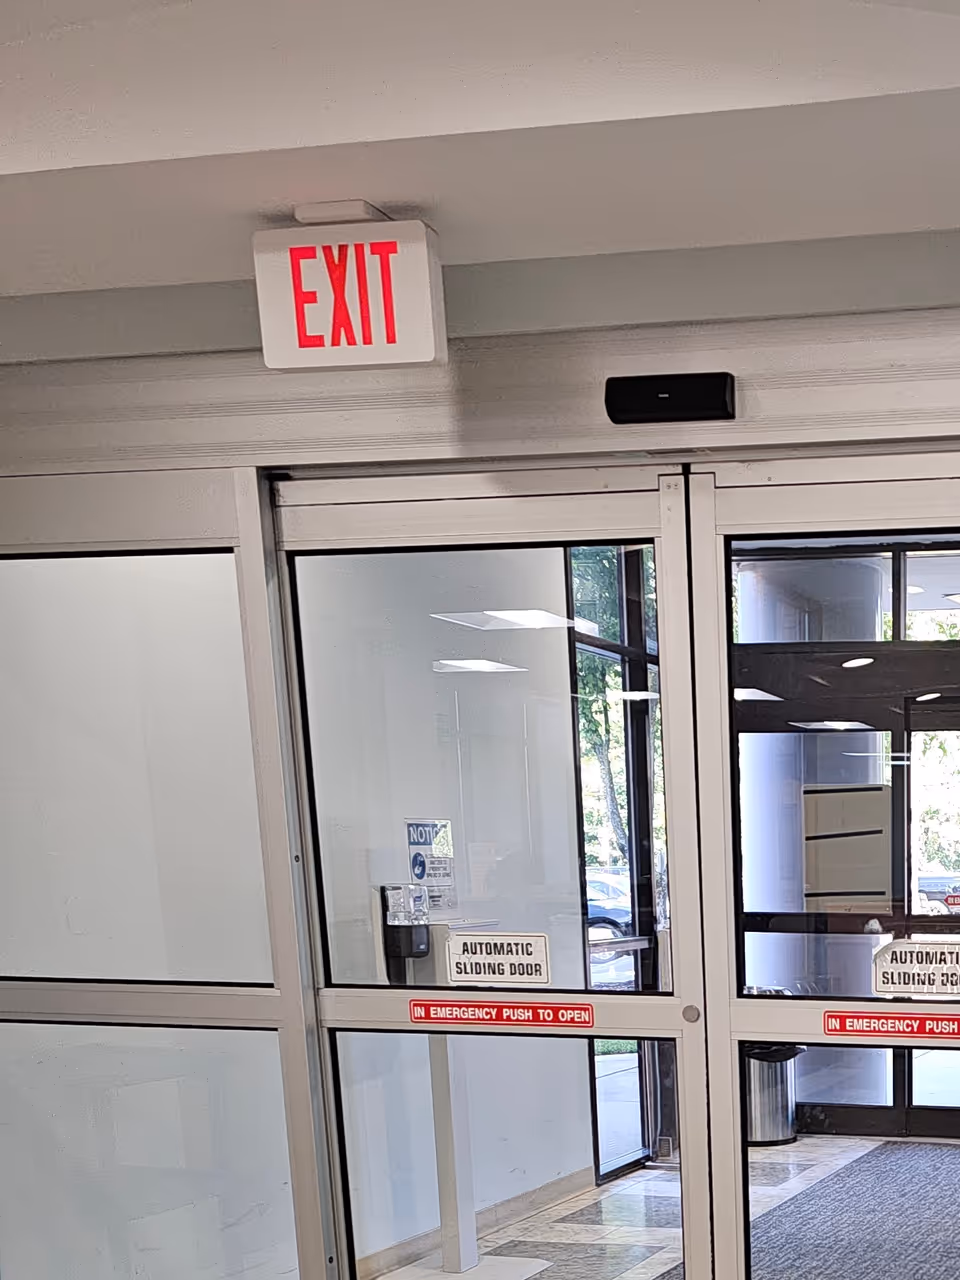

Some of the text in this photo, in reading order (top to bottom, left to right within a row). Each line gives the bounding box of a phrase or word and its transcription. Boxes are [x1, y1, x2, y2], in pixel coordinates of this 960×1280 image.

[289, 241, 398, 348] EXIT
[462, 942, 533, 956] AUTOMATIC
[455, 962, 542, 977] SLIDING DOOR
[882, 971, 936, 986] SLIDING
[414, 1006, 590, 1022] IN EMERGENCY PUSH TO OPEN
[828, 1018, 840, 1030] IN
[845, 1018, 920, 1032] EMERGENCY
[925, 1020, 958, 1033] PUSH
